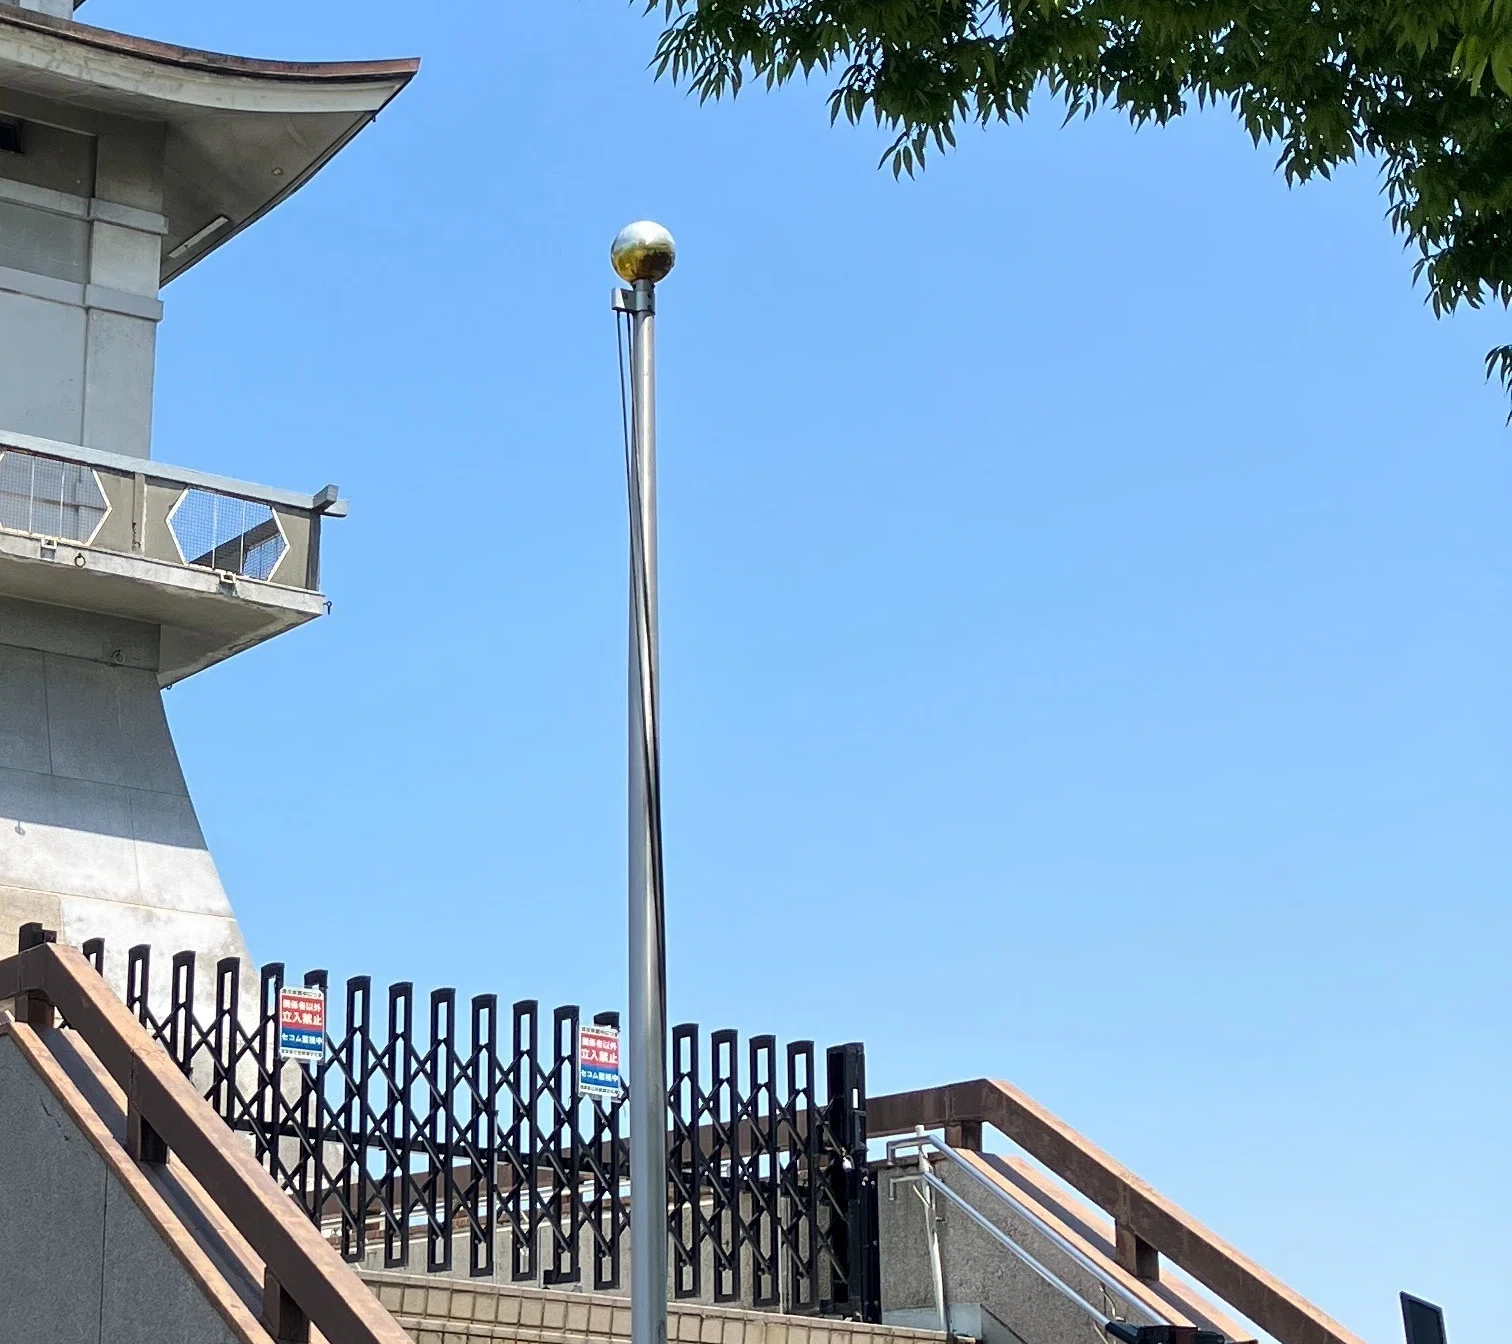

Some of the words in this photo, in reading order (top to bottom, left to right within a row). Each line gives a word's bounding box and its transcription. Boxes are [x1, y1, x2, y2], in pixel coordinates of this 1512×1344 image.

[282, 1010, 323, 1026] 立入禁止
[581, 1048, 618, 1064] 立入禁止
